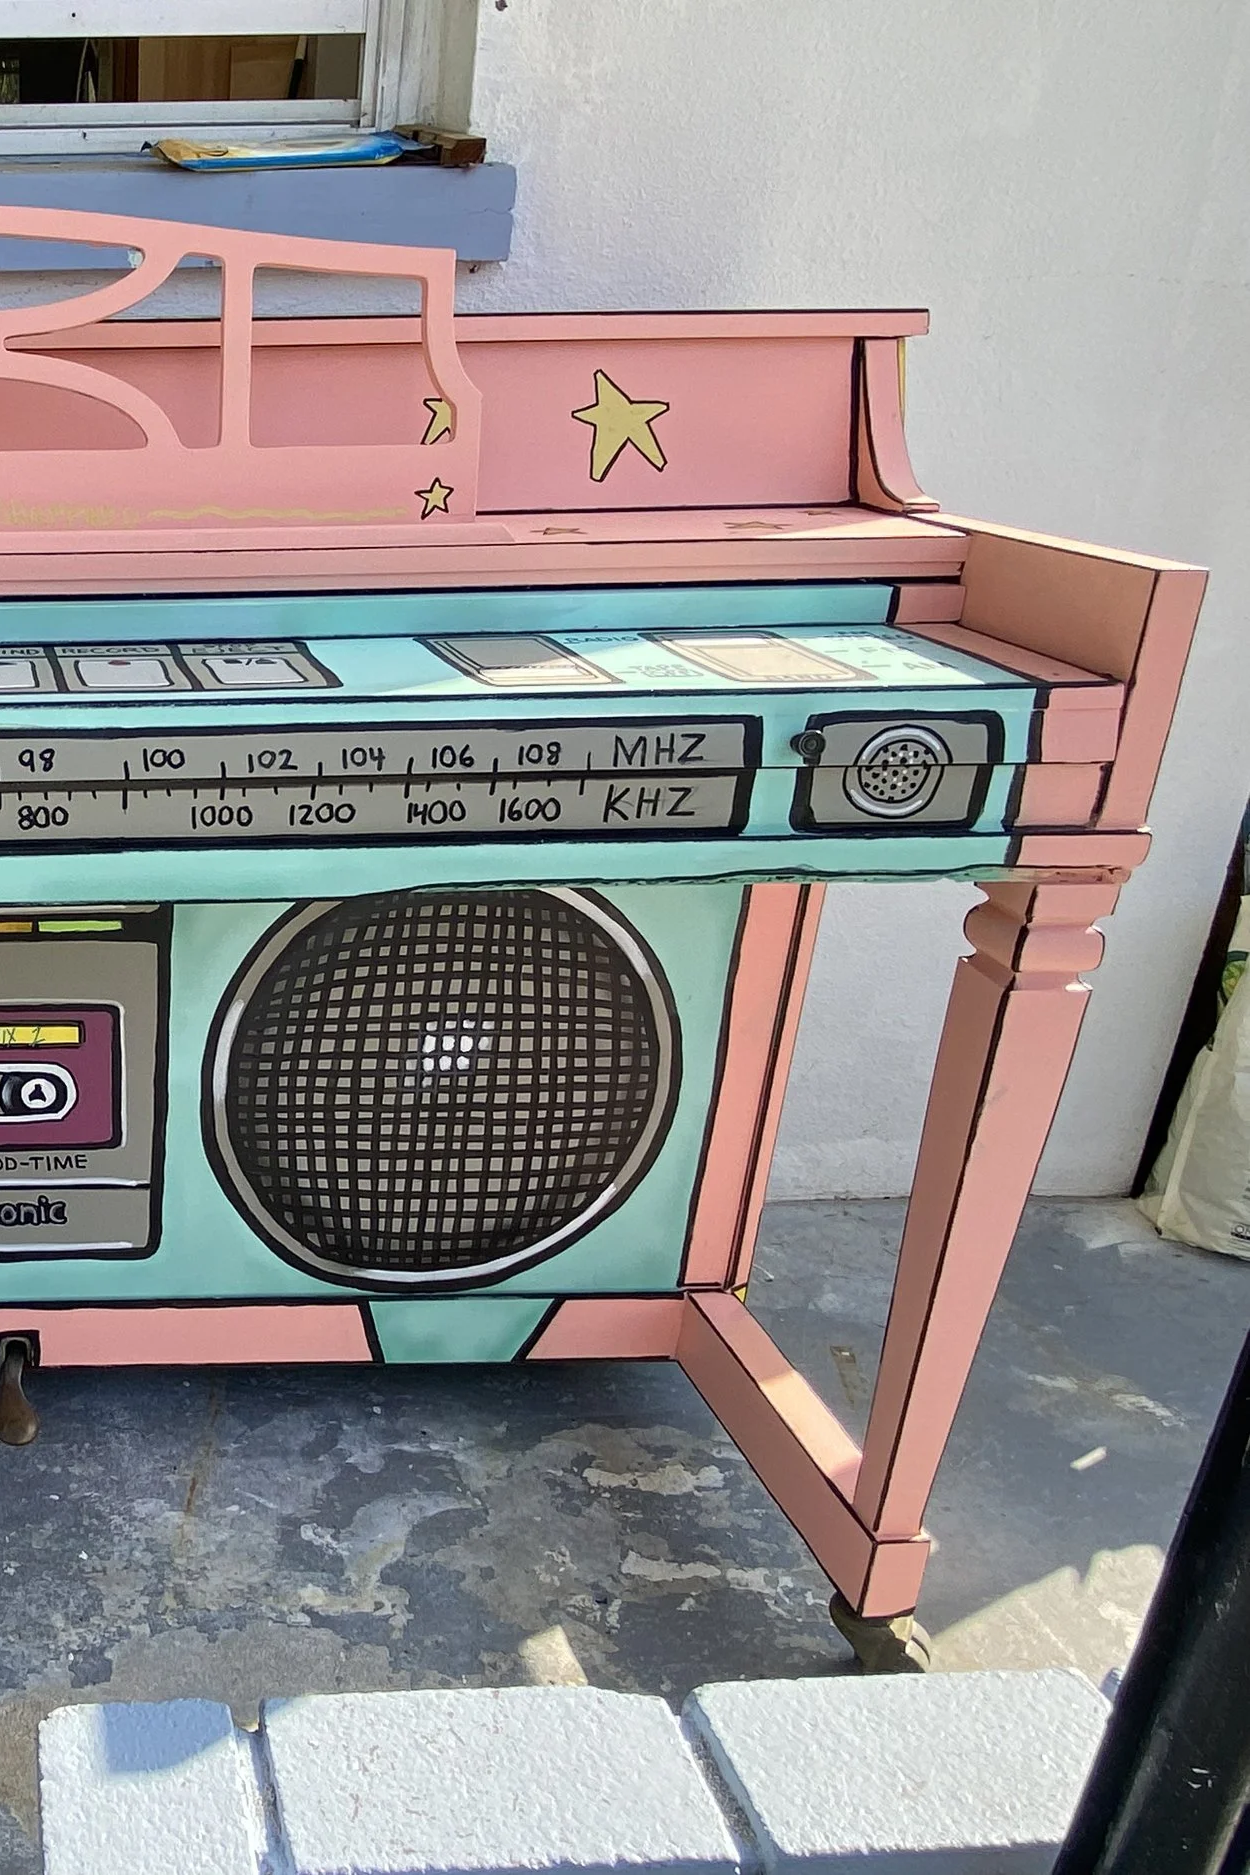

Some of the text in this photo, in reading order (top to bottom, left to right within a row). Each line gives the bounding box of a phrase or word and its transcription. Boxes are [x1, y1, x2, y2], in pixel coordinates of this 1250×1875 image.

[60, 646, 160, 655] RECORD
[18, 748, 56, 773] 98
[143, 747, 186, 772] 100
[248, 749, 299, 773] 102
[341, 746, 386, 771] 104
[431, 744, 476, 769] 106
[517, 741, 562, 766] 108
[612, 732, 707, 768] MHZ
[17, 805, 69, 831] 800
[191, 805, 254, 830] 1000
[289, 802, 357, 827] 1200
[407, 799, 467, 826] 1400
[500, 796, 562, 824] 1600
[603, 783, 696, 823] KHZ
